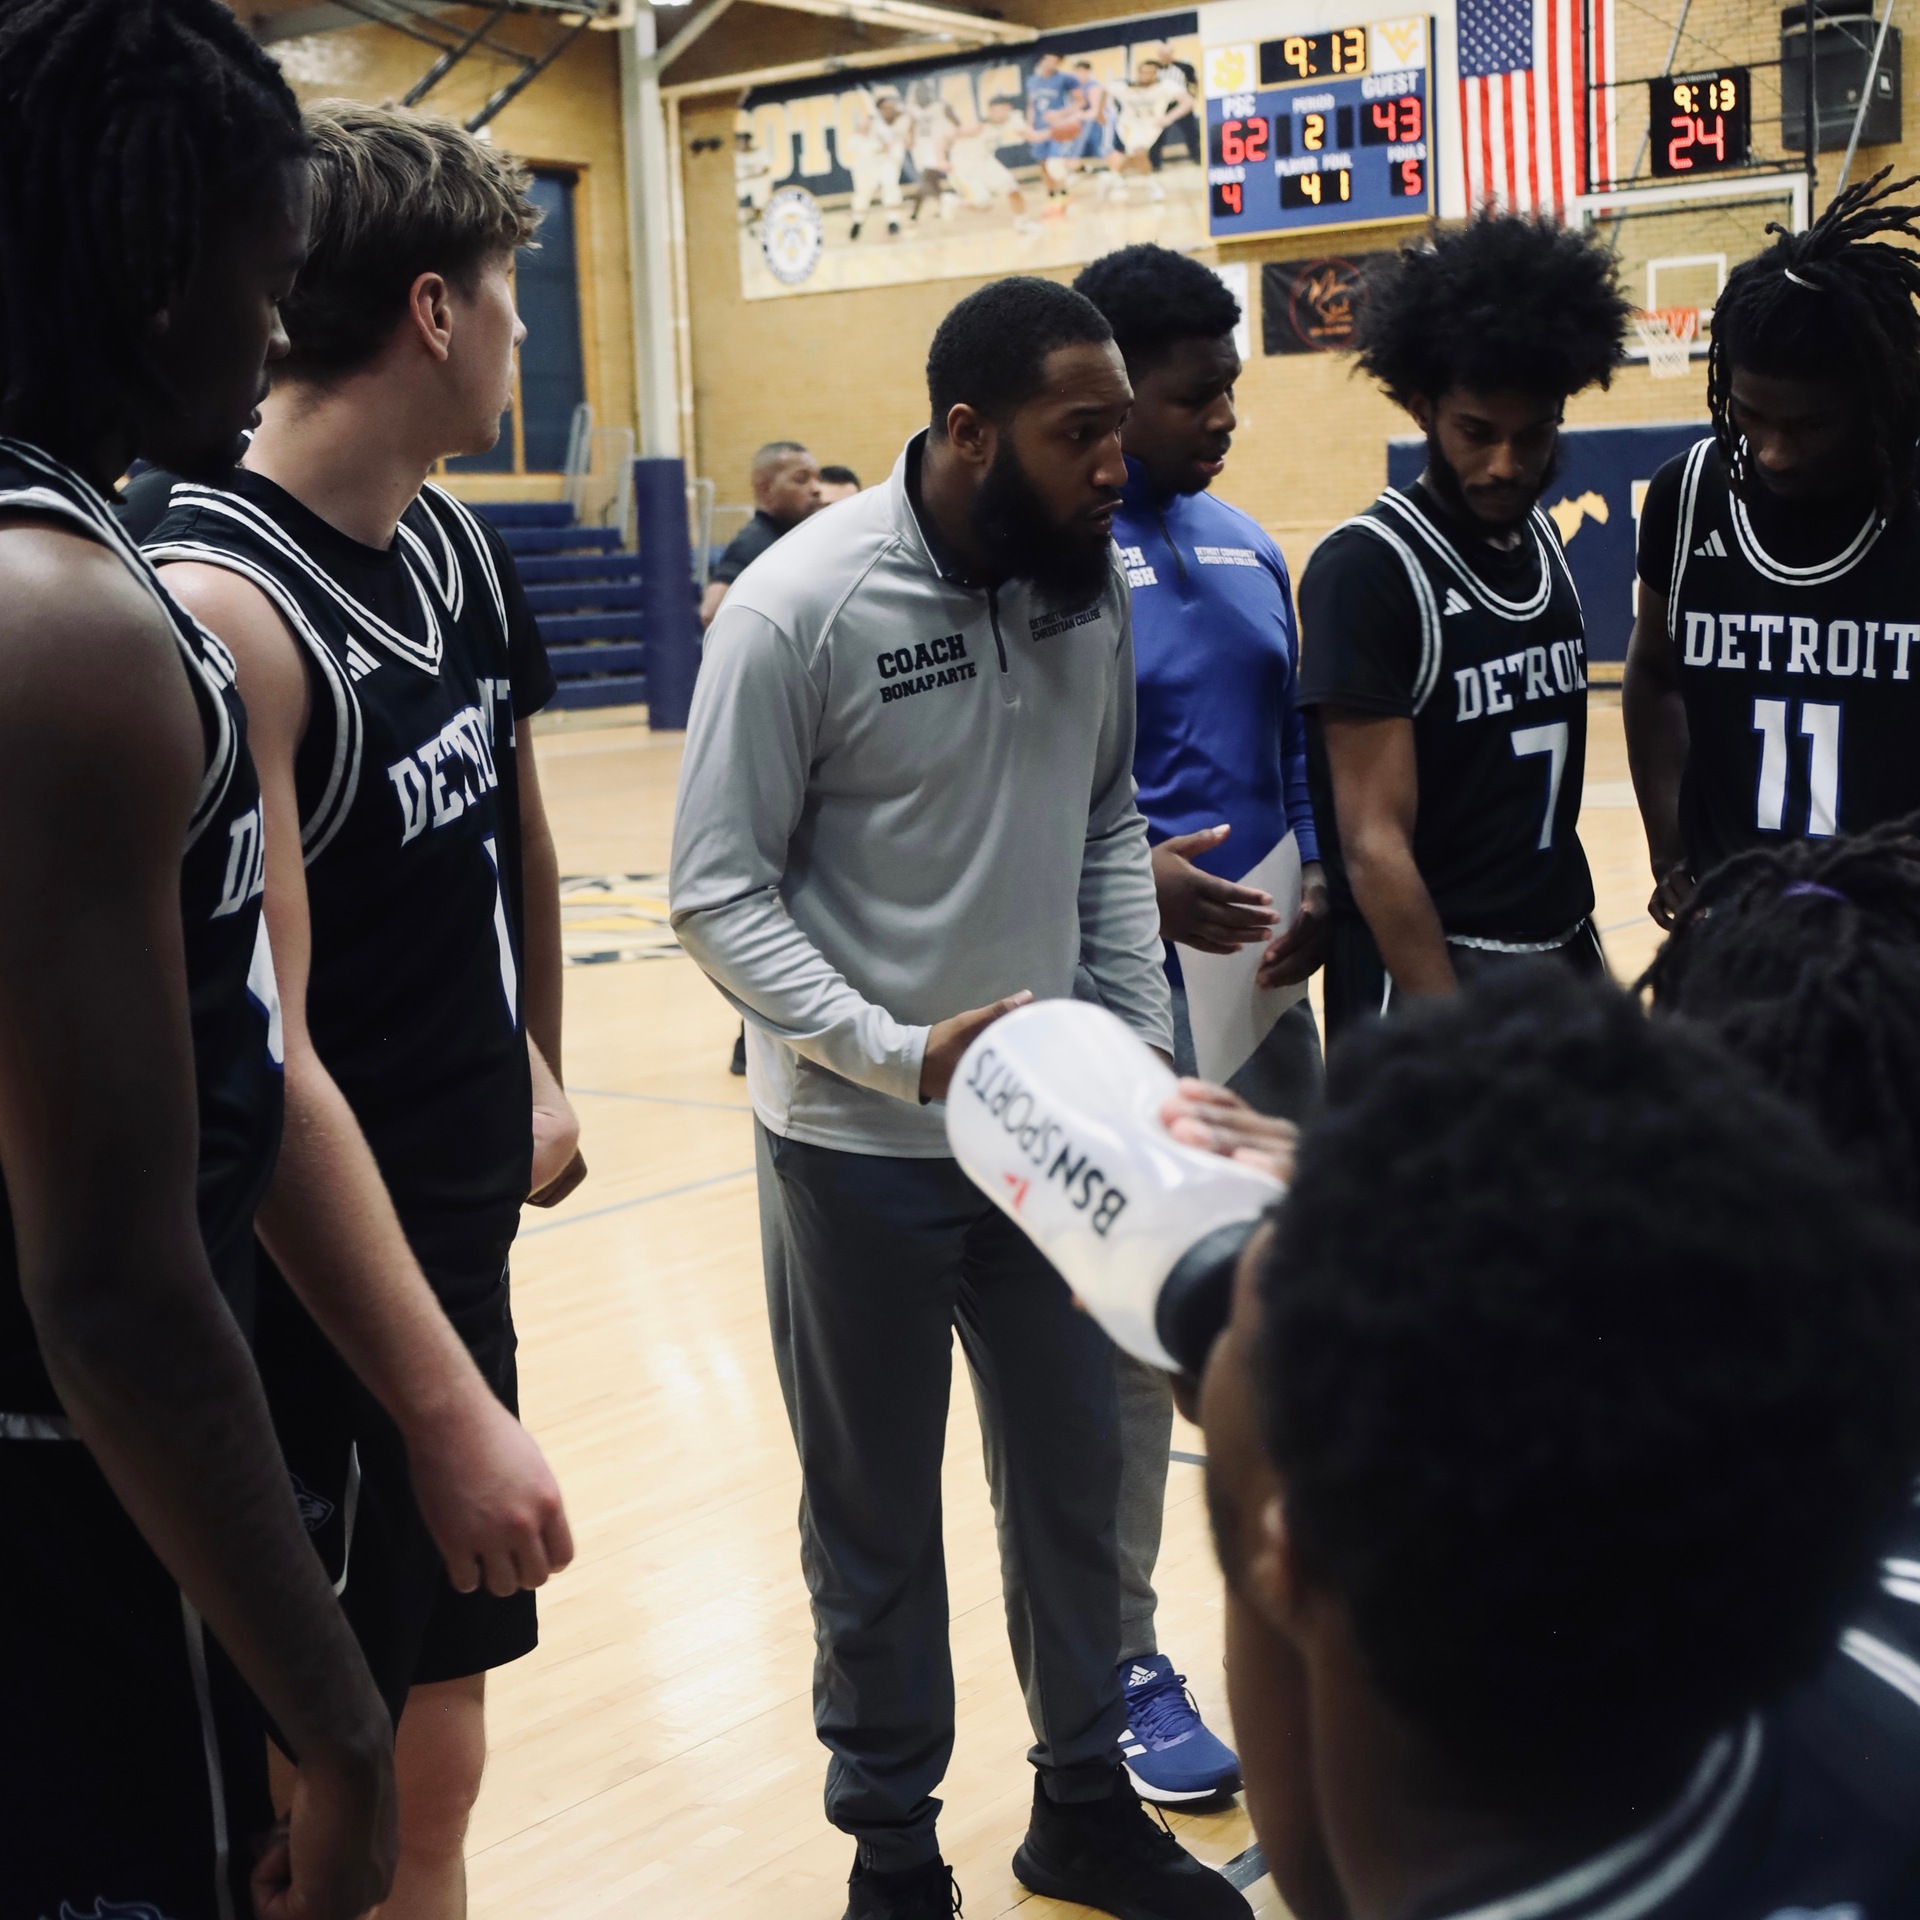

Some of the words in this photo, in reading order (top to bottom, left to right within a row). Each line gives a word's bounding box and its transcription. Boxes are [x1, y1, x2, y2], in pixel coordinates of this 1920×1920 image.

[1283, 28, 1366, 78] 9:13
[1361, 71, 1419, 99] GUEST
[1673, 78, 1736, 114] 9:13
[1221, 117, 1268, 165] 62
[1304, 113, 1324, 150] 2
[1372, 96, 1421, 142] 43
[1668, 114, 1724, 170] 24
[1221, 184, 1242, 214] 4
[1401, 160, 1422, 196] 5
[1032, 617, 1076, 642] CHRISTIAN
[1075, 607, 1101, 626] COLLEGE
[1684, 611, 1920, 680] DETROIT
[877, 633, 967, 679] COACH
[880, 662, 977, 703] BONAPARTE
[1510, 722, 1568, 850] 7
[1754, 698, 1841, 836] 11
